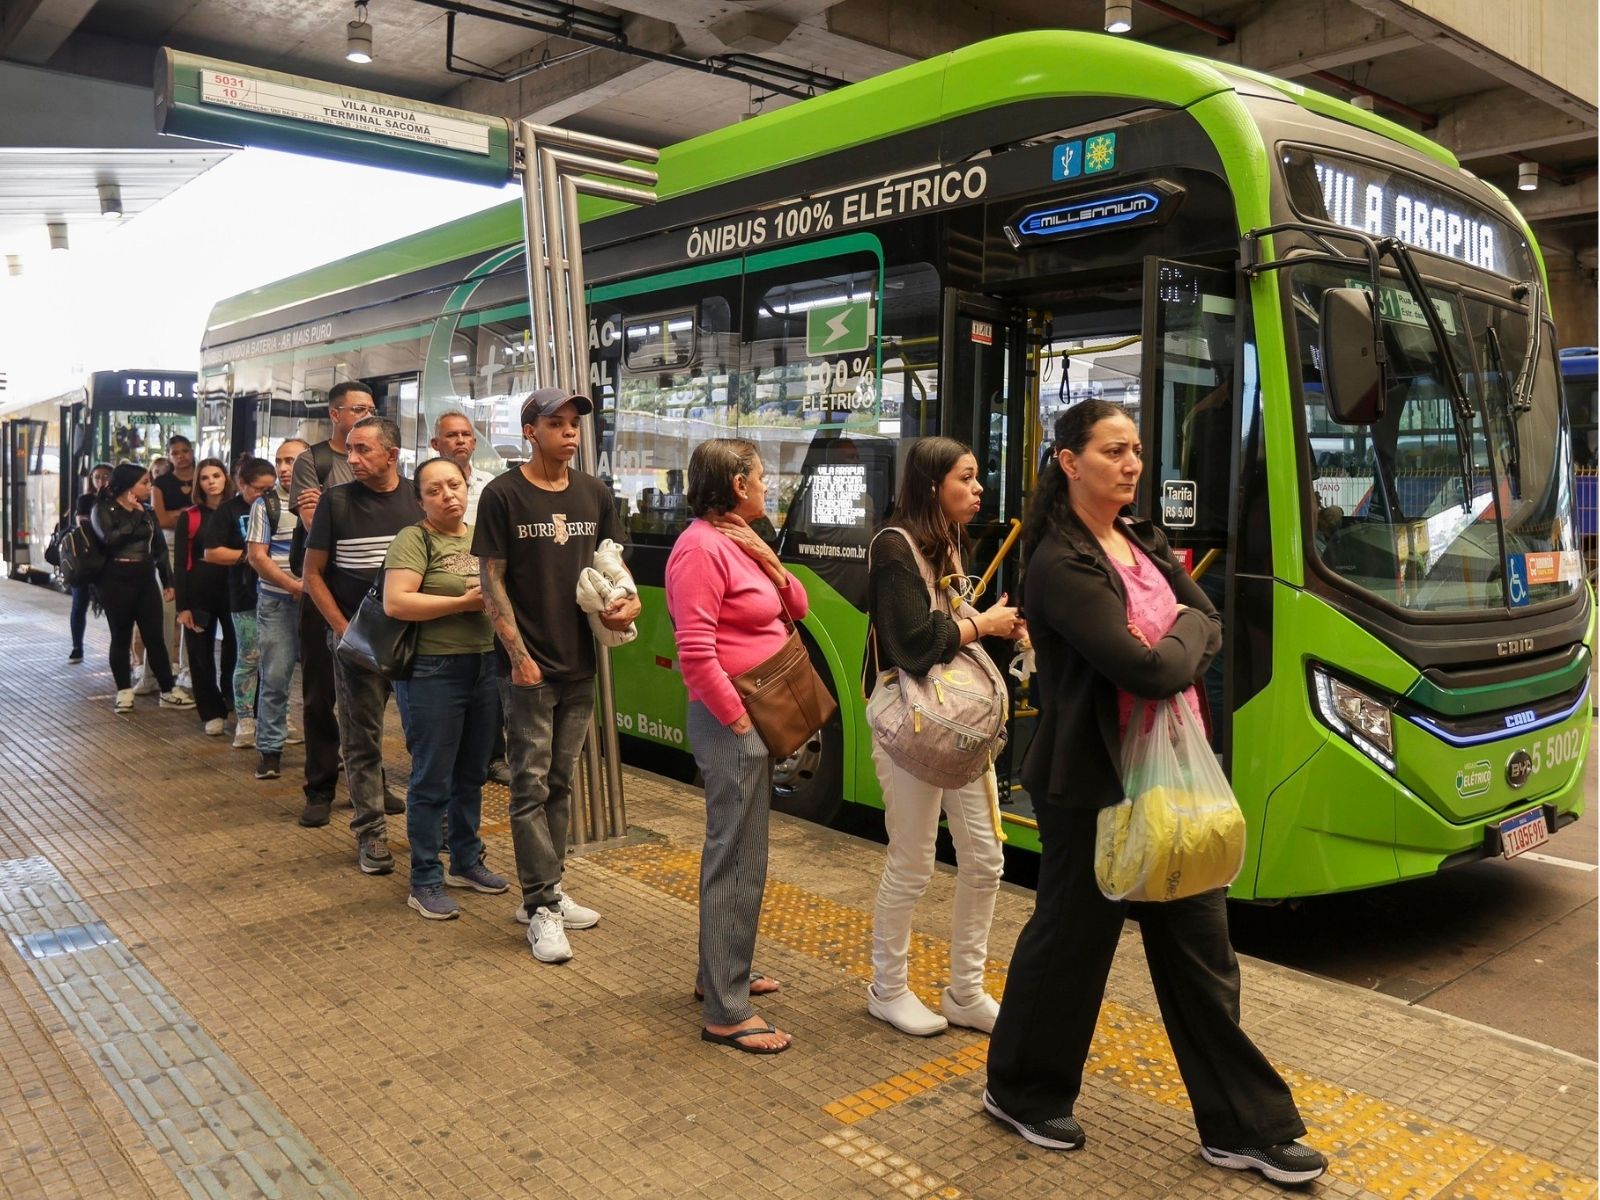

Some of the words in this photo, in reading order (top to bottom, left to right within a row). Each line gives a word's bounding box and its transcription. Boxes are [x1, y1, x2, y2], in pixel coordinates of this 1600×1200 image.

[215, 75, 244, 88] 5031
[223, 88, 237, 98] 10
[342, 100, 367, 113] VILA
[323, 107, 382, 126] TERMINAL
[687, 217, 766, 258] ÔNIBUS
[775, 200, 833, 239] 100%
[842, 166, 987, 224] ELÉTRICO
[312, 322, 332, 341] PURO
[803, 357, 874, 394] 100%
[126, 379, 183, 398] TERM.
[1167, 486, 1192, 501] Tarifa
[1165, 506, 1176, 519] R$
[1178, 506, 1193, 520] 5,00
[798, 543, 867, 559] www.sptrans.com.br
[1497, 638, 1534, 656] CAIO
[616, 712, 633, 730] so
[637, 713, 684, 744] Baixo
[1505, 710, 1536, 728] CAIO
[1532, 741, 1541, 774] 5
[1546, 730, 1579, 769] 5002
[1463, 769, 1492, 788] ELÉTRICO
